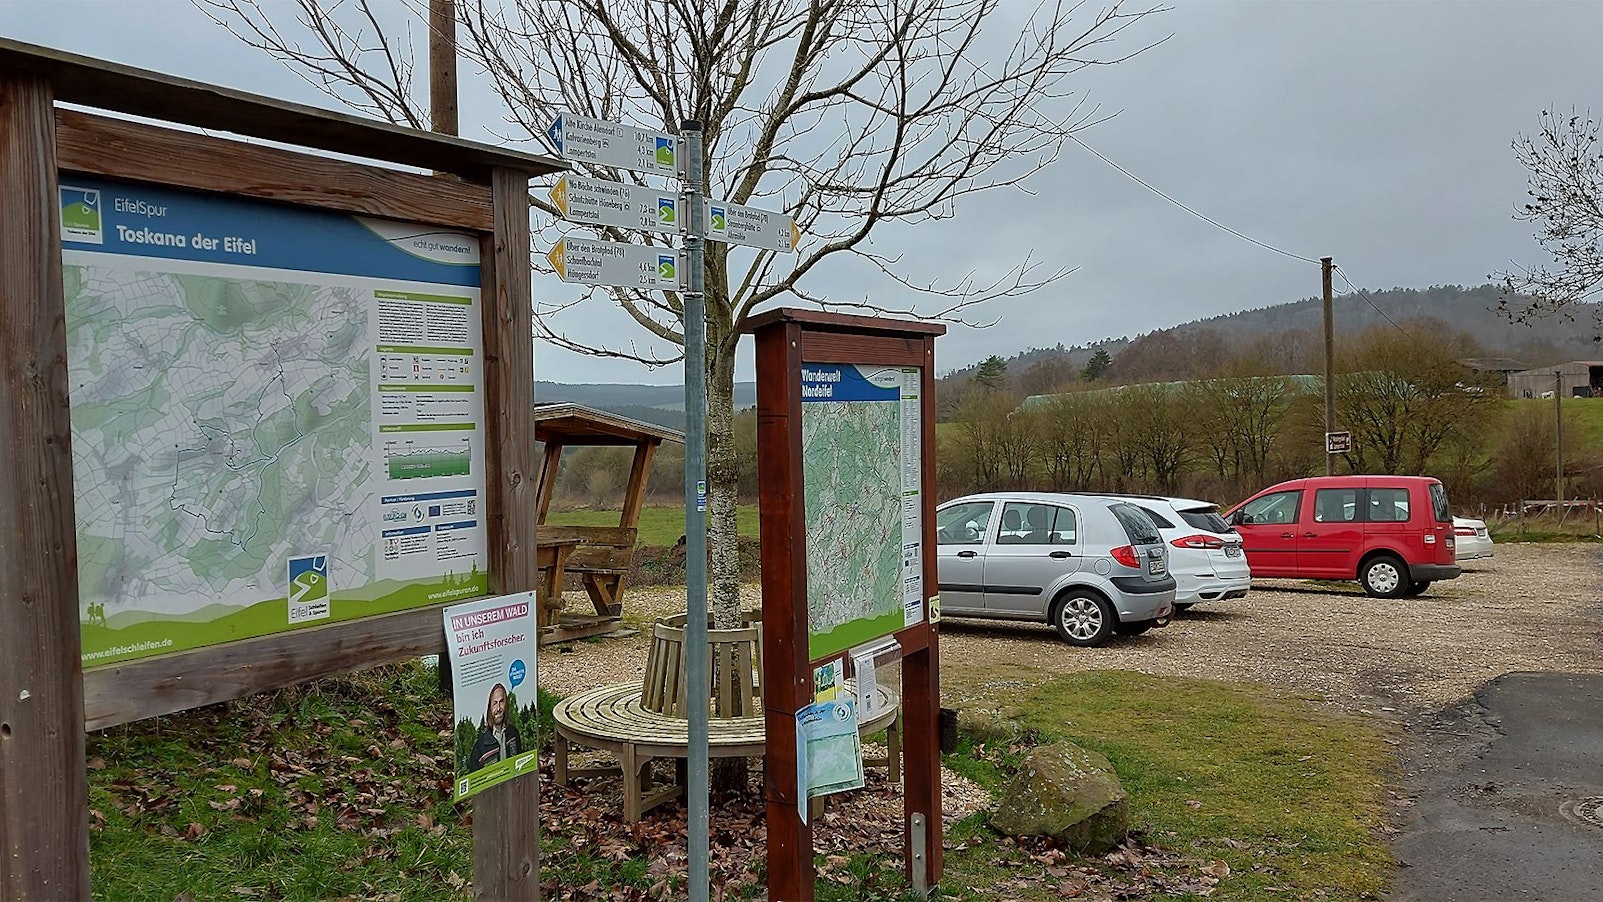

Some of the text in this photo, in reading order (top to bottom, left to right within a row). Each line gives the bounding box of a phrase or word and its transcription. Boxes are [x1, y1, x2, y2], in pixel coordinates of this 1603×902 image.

[576, 119, 593, 131] Kirche
[566, 132, 602, 148] Kalvarienberg
[646, 134, 654, 144] km
[637, 146, 654, 157] 4,3 km
[646, 160, 654, 170] km
[578, 180, 593, 192] Bäche
[594, 184, 618, 196] schwinden
[114, 198, 167, 218] EifelSpur
[570, 206, 600, 219] Lampertstal
[640, 204, 656, 214] 7,3 km
[648, 218, 656, 227] km
[116, 225, 256, 254] Toskana der Eifel
[566, 240, 580, 252] Über
[580, 243, 590, 253] den
[568, 268, 600, 280] Hüngersdorf
[648, 263, 656, 272] km
[648, 276, 656, 284] km
[801, 368, 840, 382] Wanderwelt
[801, 384, 833, 398] Nordeifel
[291, 606, 308, 618] Eifel
[453, 604, 528, 630] IN UNSEREM WALD
[456, 628, 484, 644] bin ich
[81, 638, 173, 662] www.eifelschleifen.de
[458, 634, 526, 658] Zukunftsforscher.
